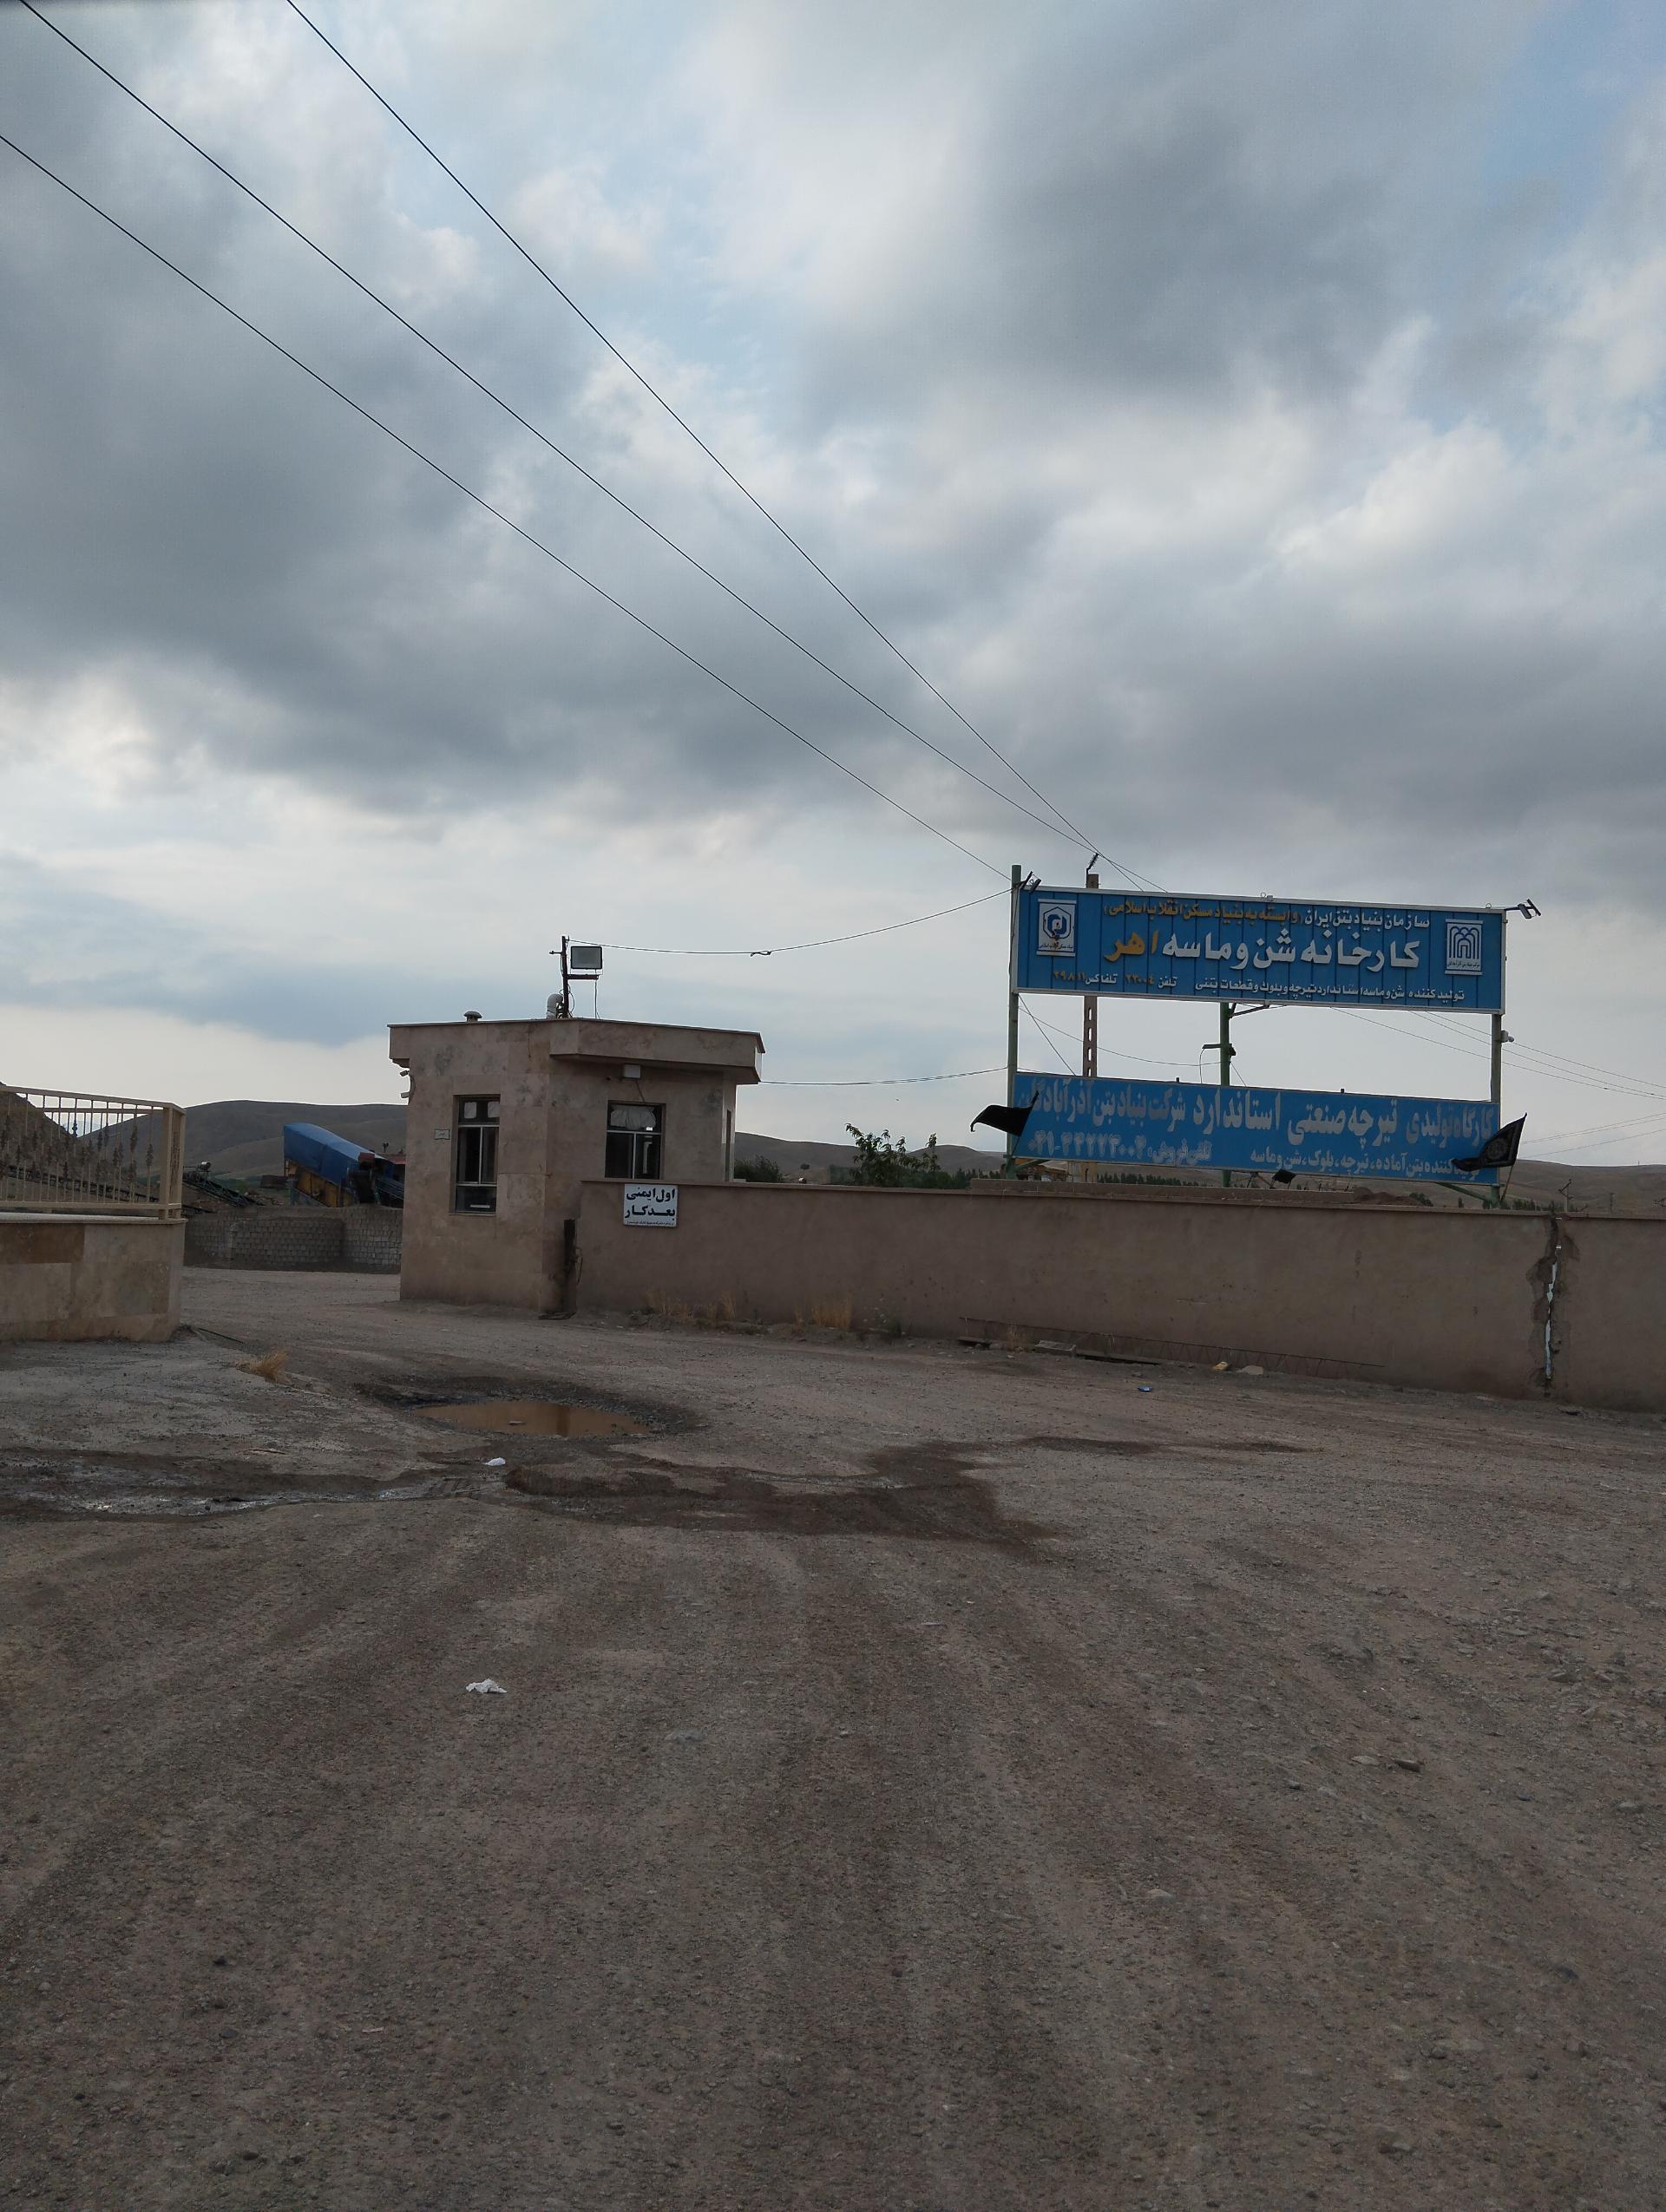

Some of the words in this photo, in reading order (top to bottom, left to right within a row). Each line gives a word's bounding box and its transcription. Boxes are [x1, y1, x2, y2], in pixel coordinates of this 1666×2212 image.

[1304, 908, 1333, 929] ایران
[1332, 908, 1353, 930] بتن
[1354, 911, 1382, 933] بنیاد
[1384, 914, 1430, 930] سازمان
[1103, 928, 1159, 963] اهر
[1162, 932, 1231, 960] ماسه
[1251, 927, 1296, 970] شن
[1299, 928, 1420, 972] کارخانه
[1228, 942, 1250, 971] و
[1084, 972, 1118, 985] تلفاکس
[1156, 975, 1177, 989] تلفن
[1194, 977, 1218, 994] بتنی
[1219, 979, 1253, 991] قطعات
[1288, 983, 1317, 999] تیرچه
[1361, 986, 1384, 998] ماسه
[1389, 985, 1405, 999] شن
[1407, 988, 1435, 999] کننده
[1436, 989, 1464, 1003] تولید
[1092, 1090, 1115, 1127] بتن
[1116, 1085, 1147, 1129] بنیاد
[1147, 1087, 1185, 1132] شرکت
[1192, 1087, 1281, 1136] استاندارد
[1286, 1103, 1346, 1146] صنعتی
[1347, 1097, 1397, 1150] تیرچه
[1406, 1103, 1453, 1149] تولیدی
[1250, 1145, 1276, 1164] ماسه
[1282, 1149, 1301, 1170] شن
[1405, 1158, 1423, 1179] بتن
[626, 1187, 656, 1201] ایمنی
[655, 1188, 675, 1203] اول
[624, 1204, 649, 1219] کار
[647, 1207, 675, 1221] بعد
